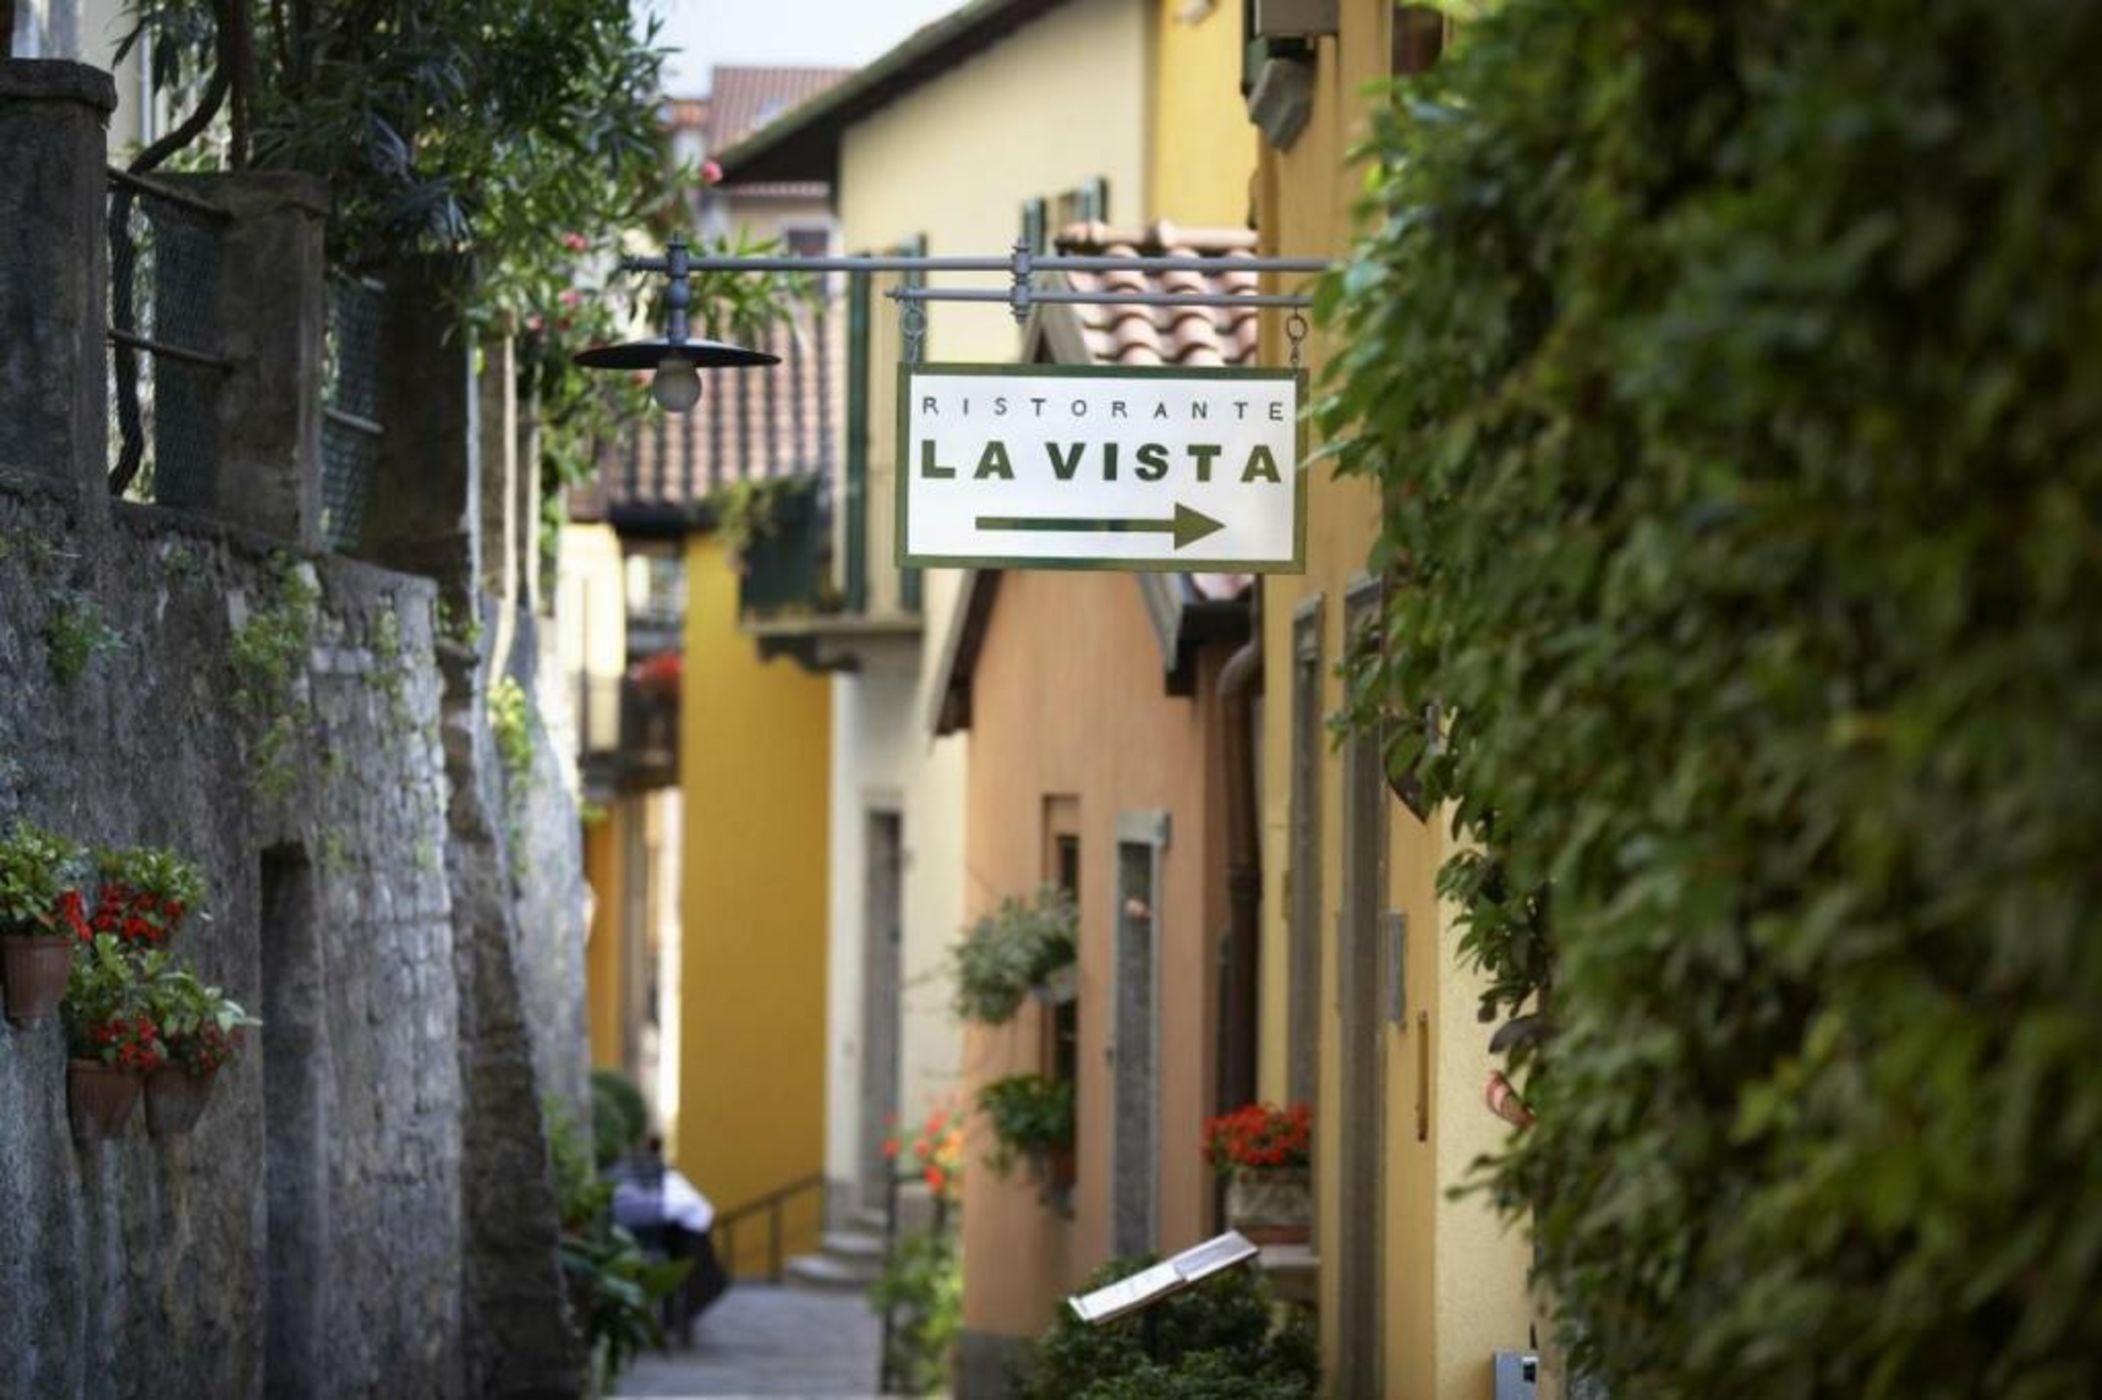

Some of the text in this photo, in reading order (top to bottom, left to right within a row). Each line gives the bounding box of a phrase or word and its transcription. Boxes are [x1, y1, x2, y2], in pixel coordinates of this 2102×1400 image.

[922, 396, 1284, 421] RISTORANTE
[920, 439, 1282, 483] LA VISTA
